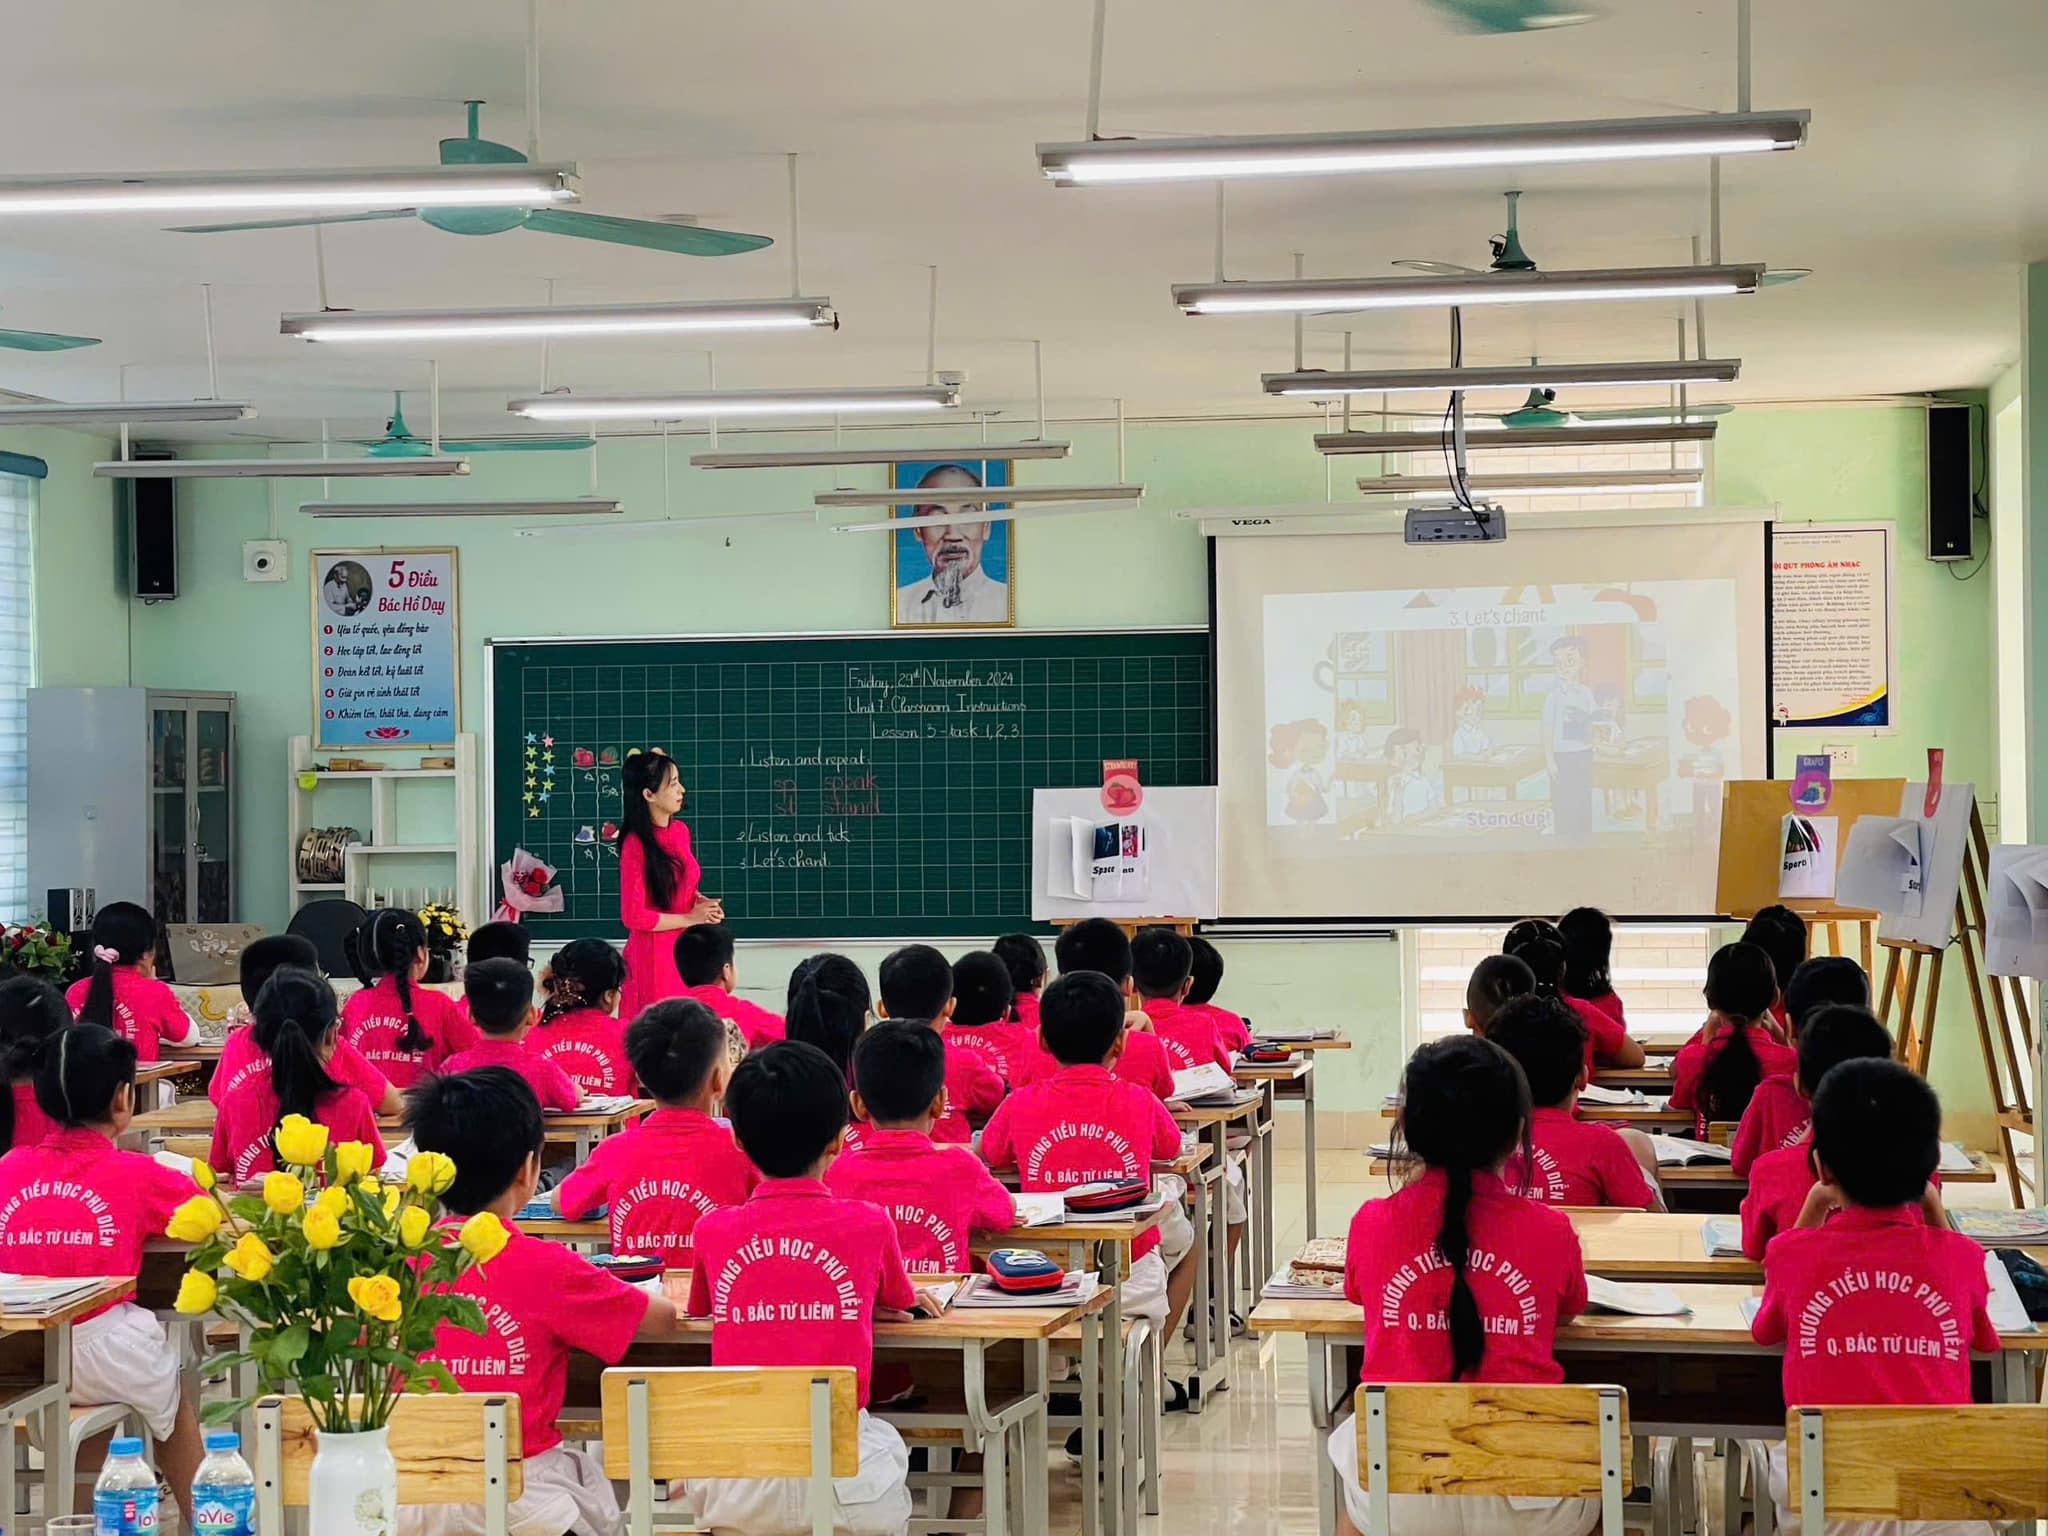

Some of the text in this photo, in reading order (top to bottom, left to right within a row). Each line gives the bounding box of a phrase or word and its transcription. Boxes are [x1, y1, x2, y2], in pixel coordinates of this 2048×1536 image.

[388, 560, 438, 588] 5 Điều
[378, 595, 445, 615] Bác Hồ Dạy
[1464, 608, 1500, 626] Let's
[1503, 607, 1546, 624] chant
[923, 666, 982, 687] November
[986, 671, 1013, 687] 2024
[848, 693, 1026, 713] Unit Classroom Instructions
[872, 720, 918, 739] Lesson
[950, 720, 978, 738] task
[750, 746, 791, 768] Listen
[795, 745, 822, 766] and
[748, 822, 789, 843] Listen
[794, 824, 821, 842] and
[827, 821, 850, 843] tick
[753, 848, 786, 868] Let's
[895, 1204, 924, 1224] HỌC
[714, 1259, 742, 1324] TRƯỜNG
[737, 1233, 775, 1265] TIỂU
[779, 1237, 814, 1261] HỌC
[813, 1248, 848, 1281] PHÚ
[1382, 1264, 1418, 1328] TRƯỜNG
[1496, 1261, 1532, 1296] PHÚ
[748, 1299, 775, 1321] BẮC
[800, 1300, 834, 1321] LIÊM
[1799, 1290, 1834, 1359] TRƯỜNG
[1828, 1266, 1870, 1299] TIỂU
[1875, 1270, 1913, 1294] HỌC
[1914, 1282, 1952, 1317] PHÚ
[1484, 1314, 1518, 1335] LIÊM
[1845, 1331, 1877, 1353] BẮC
[1905, 1335, 1941, 1358] LIÊM
[472, 1356, 506, 1376] LIÊM
